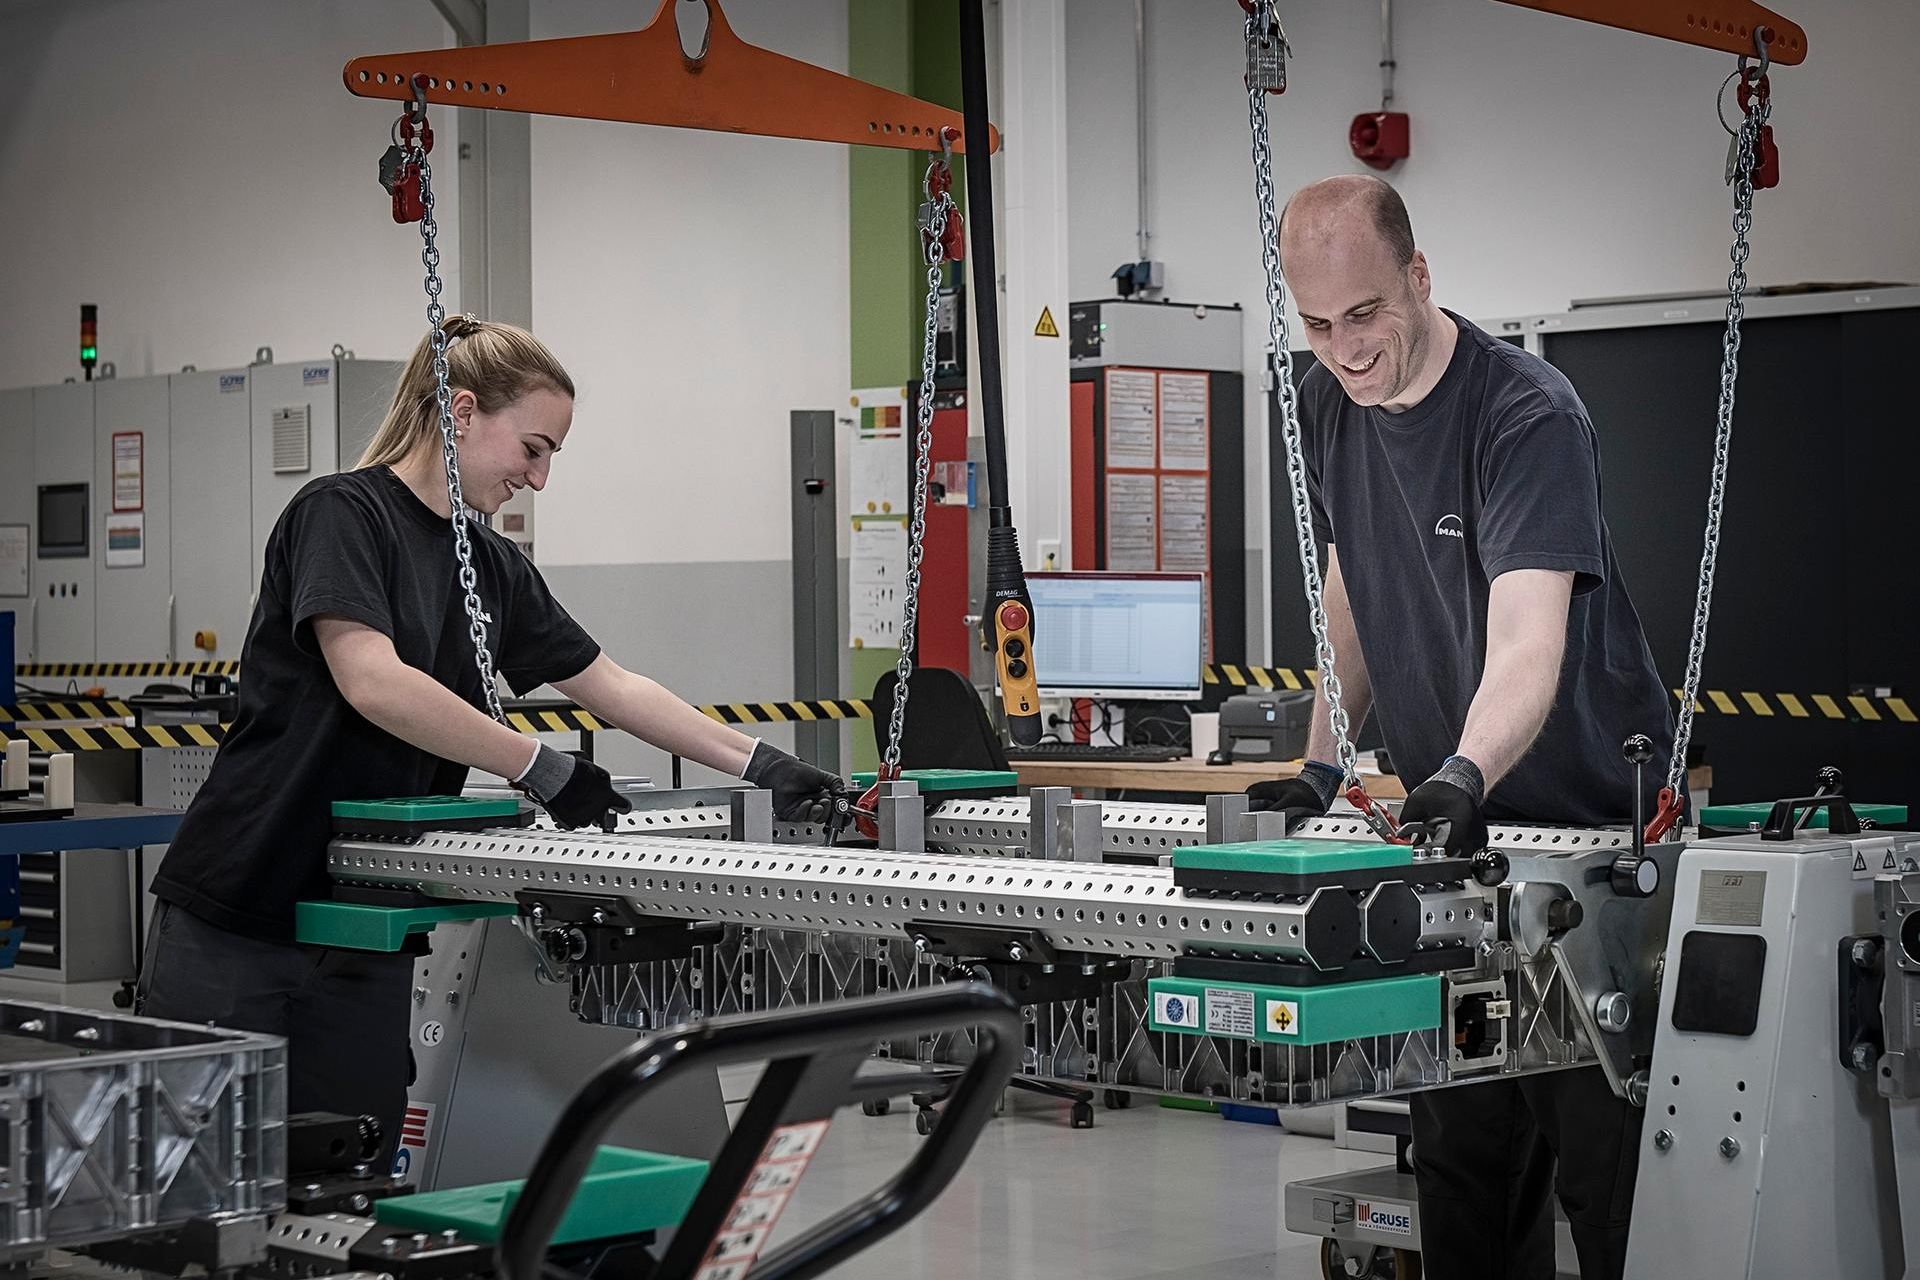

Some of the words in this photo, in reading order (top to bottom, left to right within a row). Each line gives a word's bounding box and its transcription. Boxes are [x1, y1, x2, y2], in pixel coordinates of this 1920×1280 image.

[1439, 528, 1463, 538] MAN
[424, 1024, 440, 1042] CE
[1371, 1212, 1409, 1228] GRUSE
